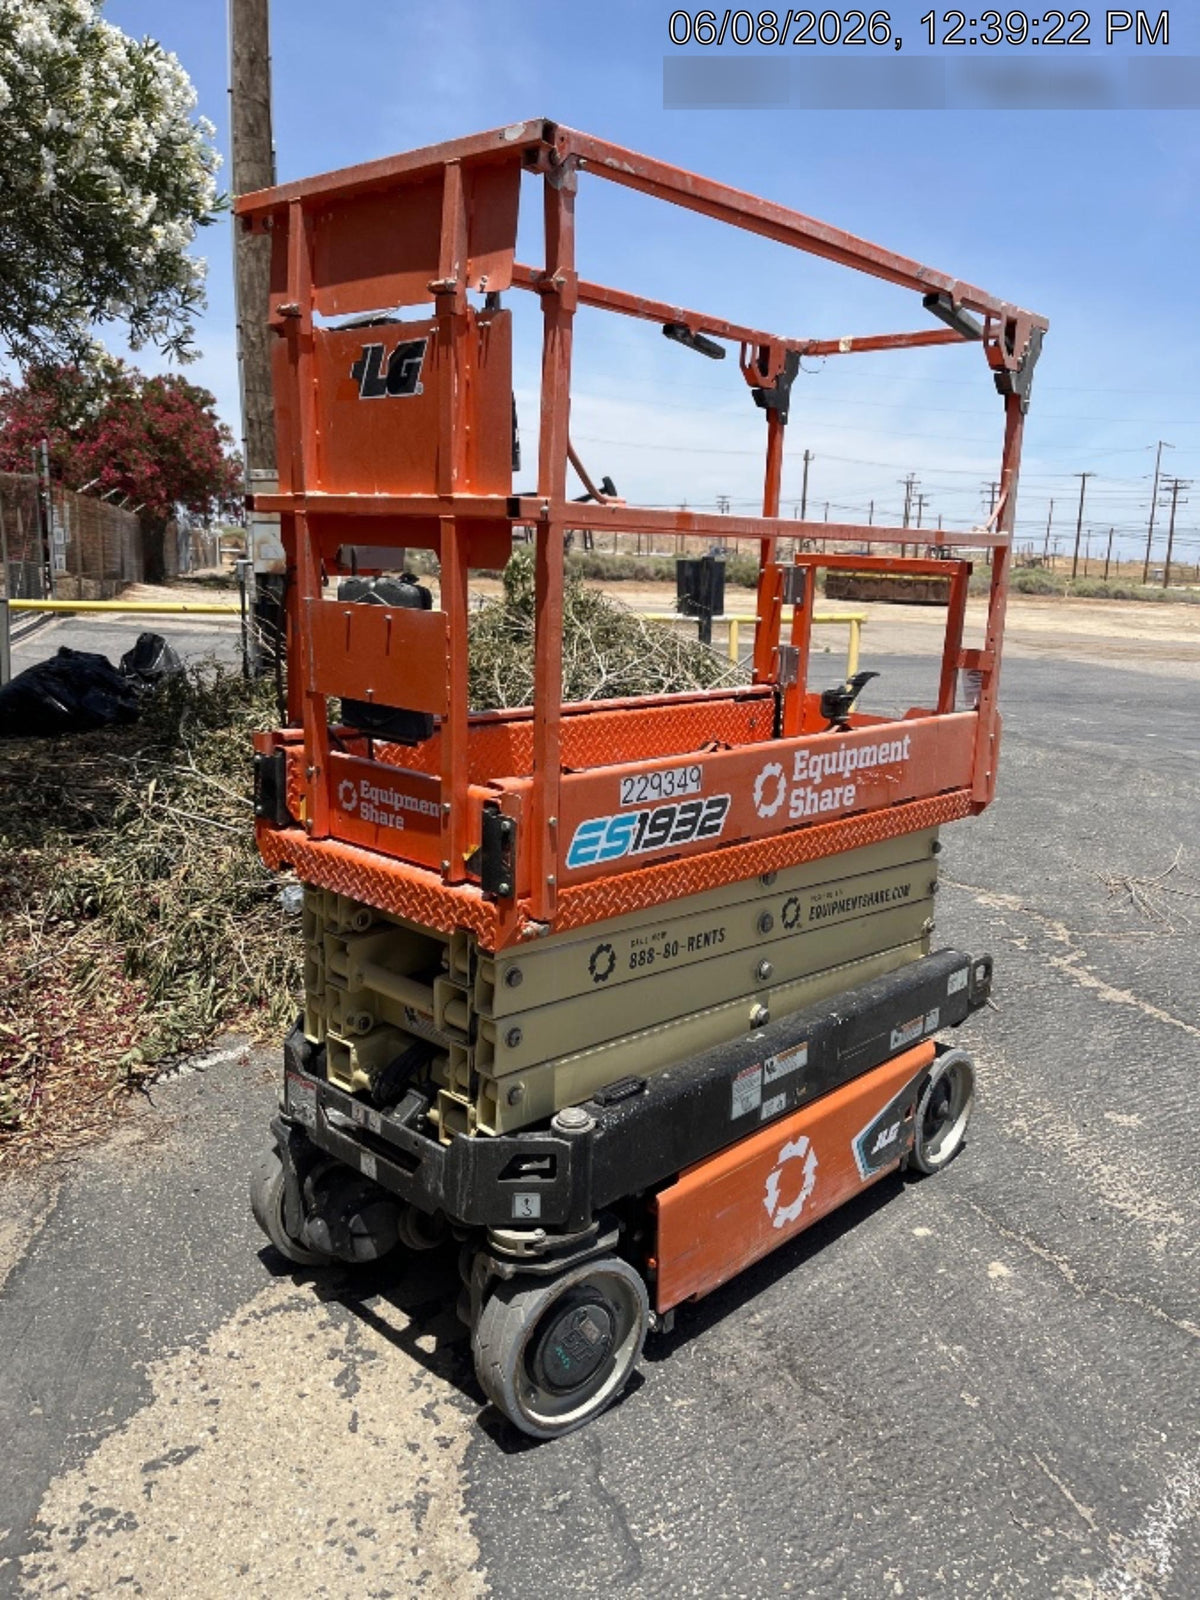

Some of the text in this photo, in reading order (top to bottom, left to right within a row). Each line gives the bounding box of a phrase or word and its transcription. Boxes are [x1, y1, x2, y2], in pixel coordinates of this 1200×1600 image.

[792, 734, 911, 784] Equipment
[360, 780, 441, 818] Equipmen
[621, 765, 701, 804] 229349
[789, 783, 856, 819] Share
[360, 801, 405, 831] Share
[566, 794, 731, 869] ES1932
[629, 927, 725, 970] 888-80-RENTS
